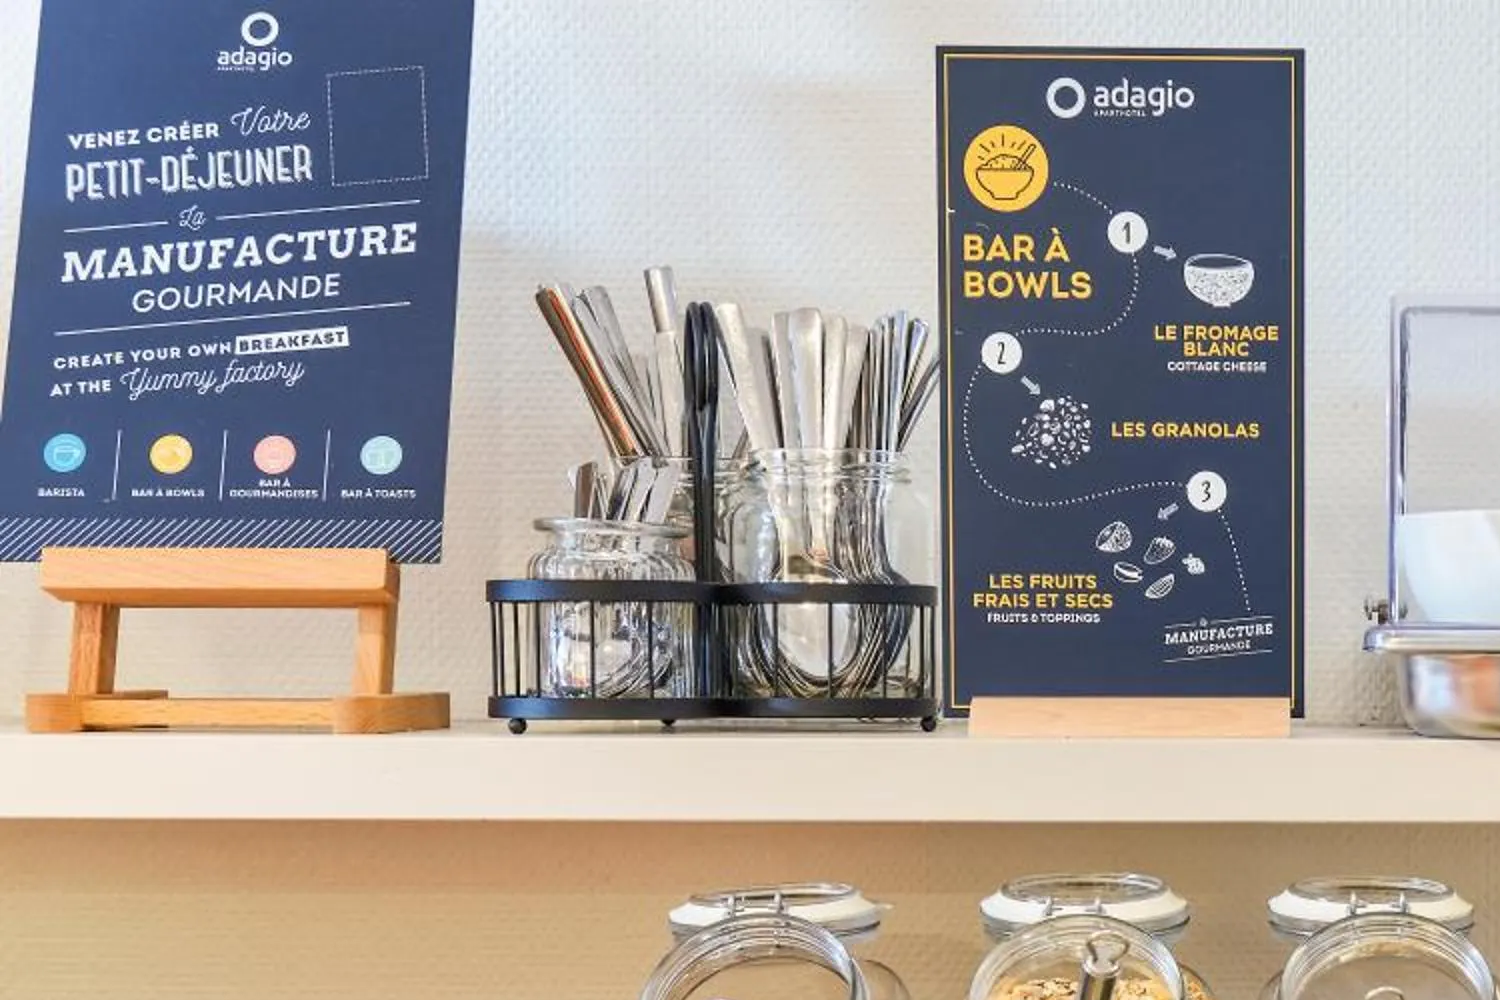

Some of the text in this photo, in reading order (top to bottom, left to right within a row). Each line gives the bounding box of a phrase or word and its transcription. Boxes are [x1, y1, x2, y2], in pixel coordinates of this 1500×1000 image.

[217, 45, 293, 71] adagio
[1094, 78, 1195, 116] adagio
[68, 105, 312, 150] VENEZ CRÉER Votre
[65, 144, 313, 203] PETIT-DÉJEUNER
[178, 204, 206, 231] La
[1122, 222, 1132, 244] 1
[61, 222, 418, 285] MANUFACTURE
[963, 227, 1070, 263] BAR À
[132, 273, 341, 313] GOURMANDE
[963, 271, 1092, 299] BOWLS
[1154, 325, 1279, 341] LE FROMAGE
[53, 329, 348, 370] CREATE YOUR OWN BREAKFAST
[997, 341, 1006, 365] 2
[1183, 342, 1250, 357] BLANC
[1167, 361, 1267, 372] COTTAGE CHEESE
[50, 358, 305, 401] AT THE Yummy factory
[1111, 422, 1260, 438] LES GRANOLAS
[37, 487, 85, 497] BARISTA
[131, 488, 153, 497] BAR
[165, 488, 205, 497] BOWLS
[229, 489, 319, 498] GOURMANDISES
[259, 479, 279, 487] BAR
[341, 489, 363, 498] BAR
[375, 489, 417, 498] TOASTS
[1201, 481, 1212, 503] 3
[989, 574, 1097, 589] LES FRUITS
[973, 593, 1113, 608] FRAIS ET SECS
[987, 613, 1028, 623] FRUITS
[1040, 613, 1100, 623] TOPPINGS
[1164, 623, 1274, 645] MANUFACTURE
[1187, 640, 1251, 655] GOURMANDE
